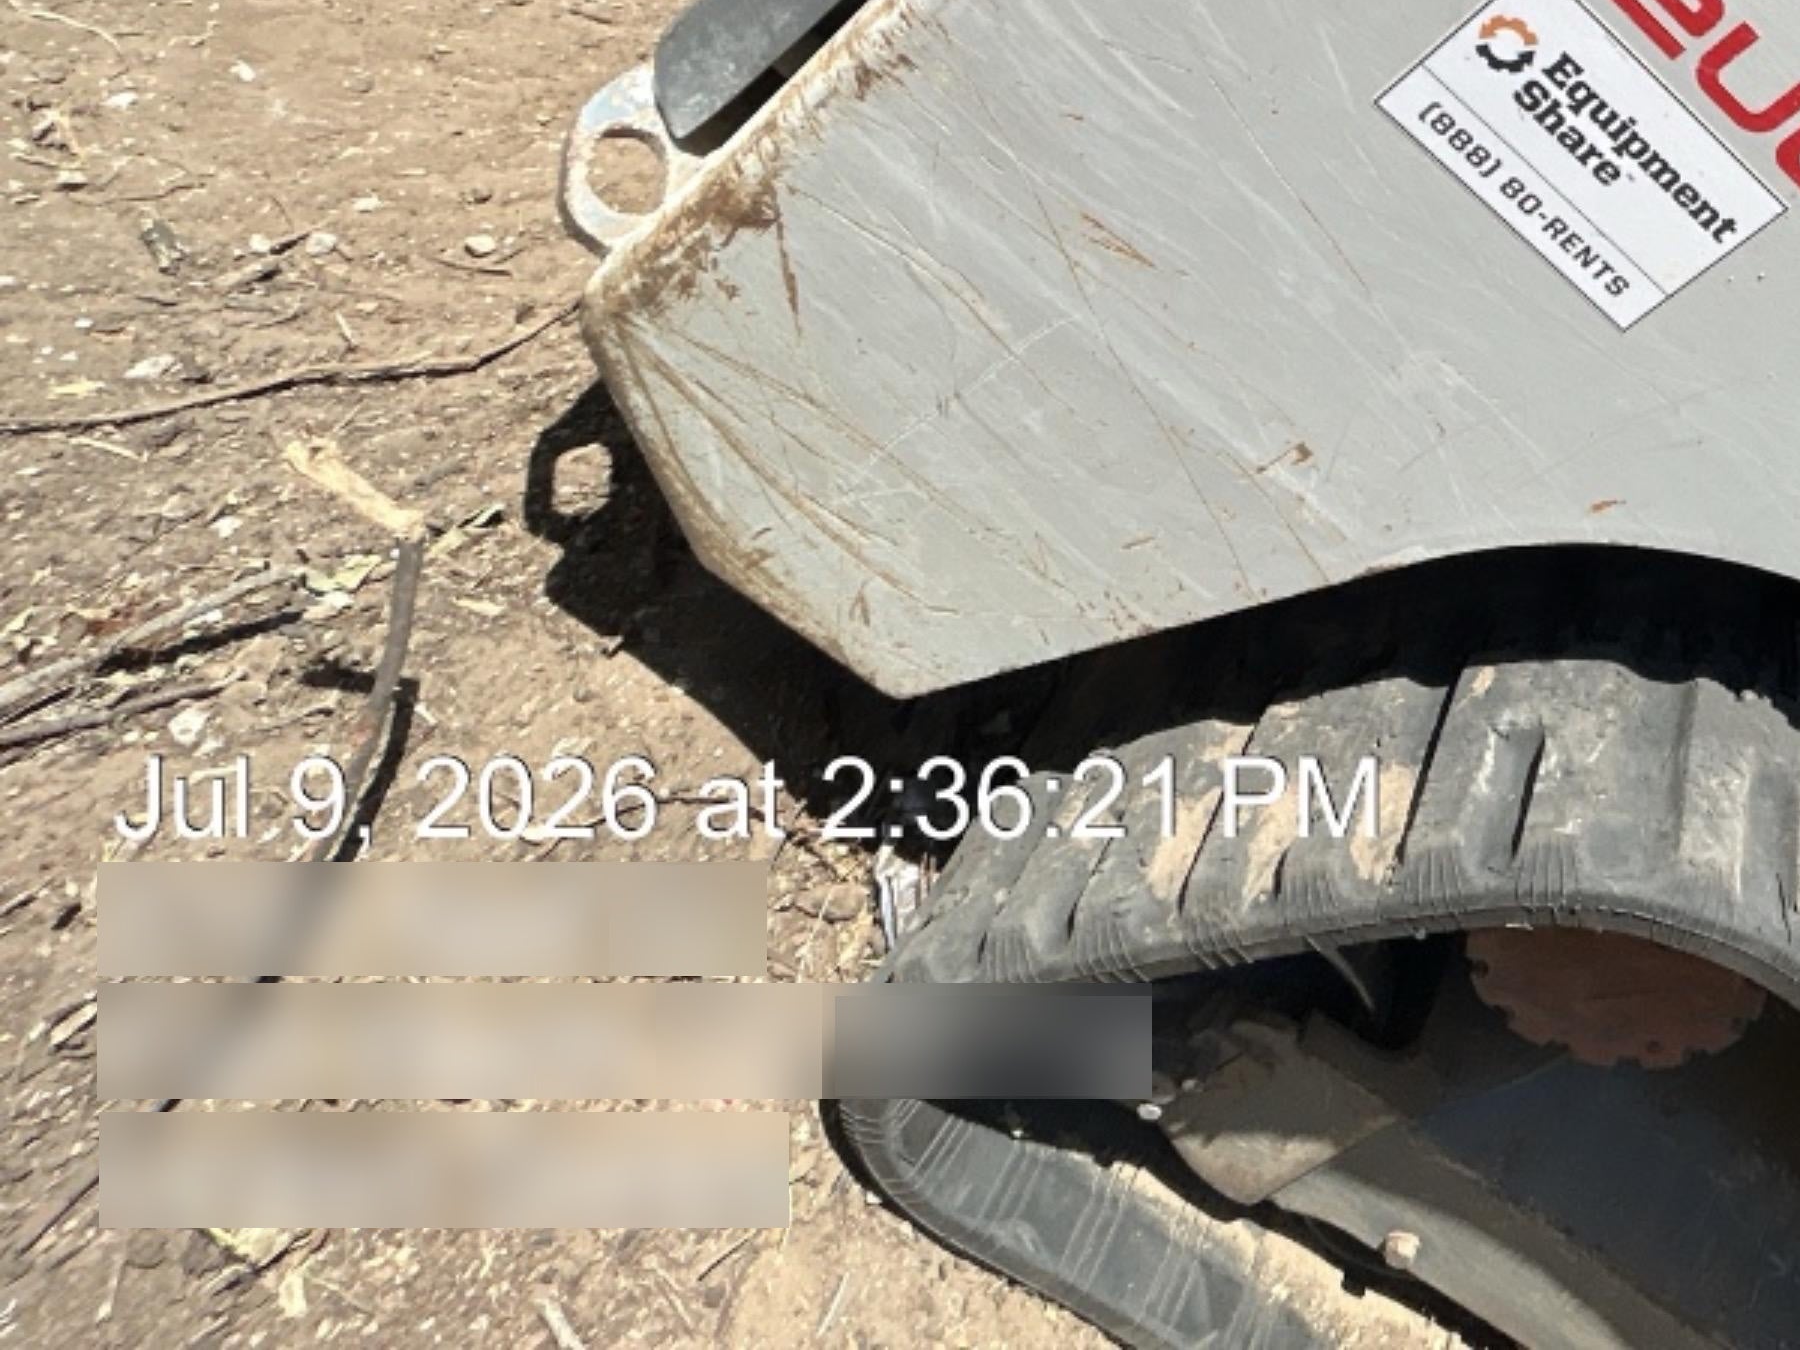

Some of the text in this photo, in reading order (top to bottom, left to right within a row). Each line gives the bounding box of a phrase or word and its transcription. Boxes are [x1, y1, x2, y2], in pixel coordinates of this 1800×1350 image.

[1417, 100, 1631, 298] (888) 80-RENTS
[1512, 78, 1621, 187] Share
[1541, 51, 1738, 245] Equipment
